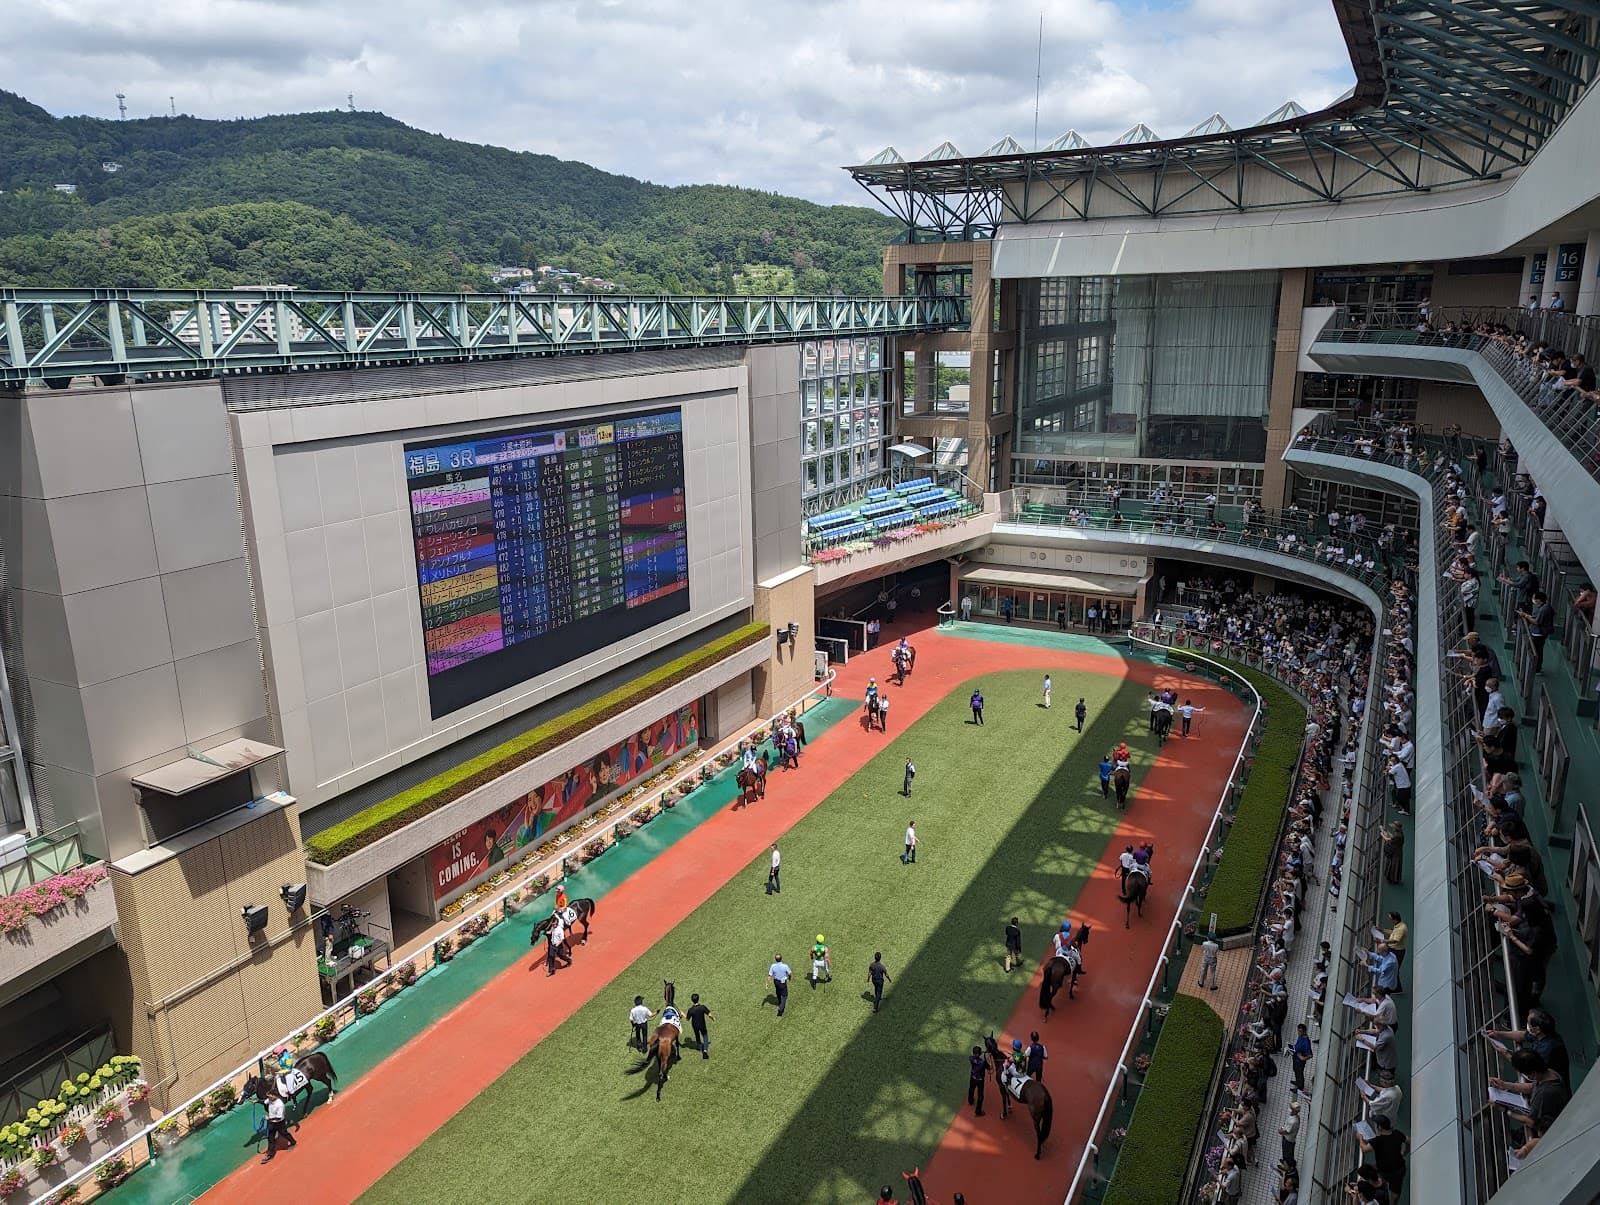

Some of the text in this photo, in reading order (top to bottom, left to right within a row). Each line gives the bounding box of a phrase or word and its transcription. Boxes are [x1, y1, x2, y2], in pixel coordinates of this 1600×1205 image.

[1562, 252, 1578, 264] 16
[1560, 270, 1574, 280] 5F
[409, 454, 440, 476] 福島
[450, 449, 474, 468] 3R
[446, 472, 463, 484] 馬名
[452, 842, 462, 860] IS
[438, 852, 480, 886] COMING.
[294, 1072, 304, 1085] 15
